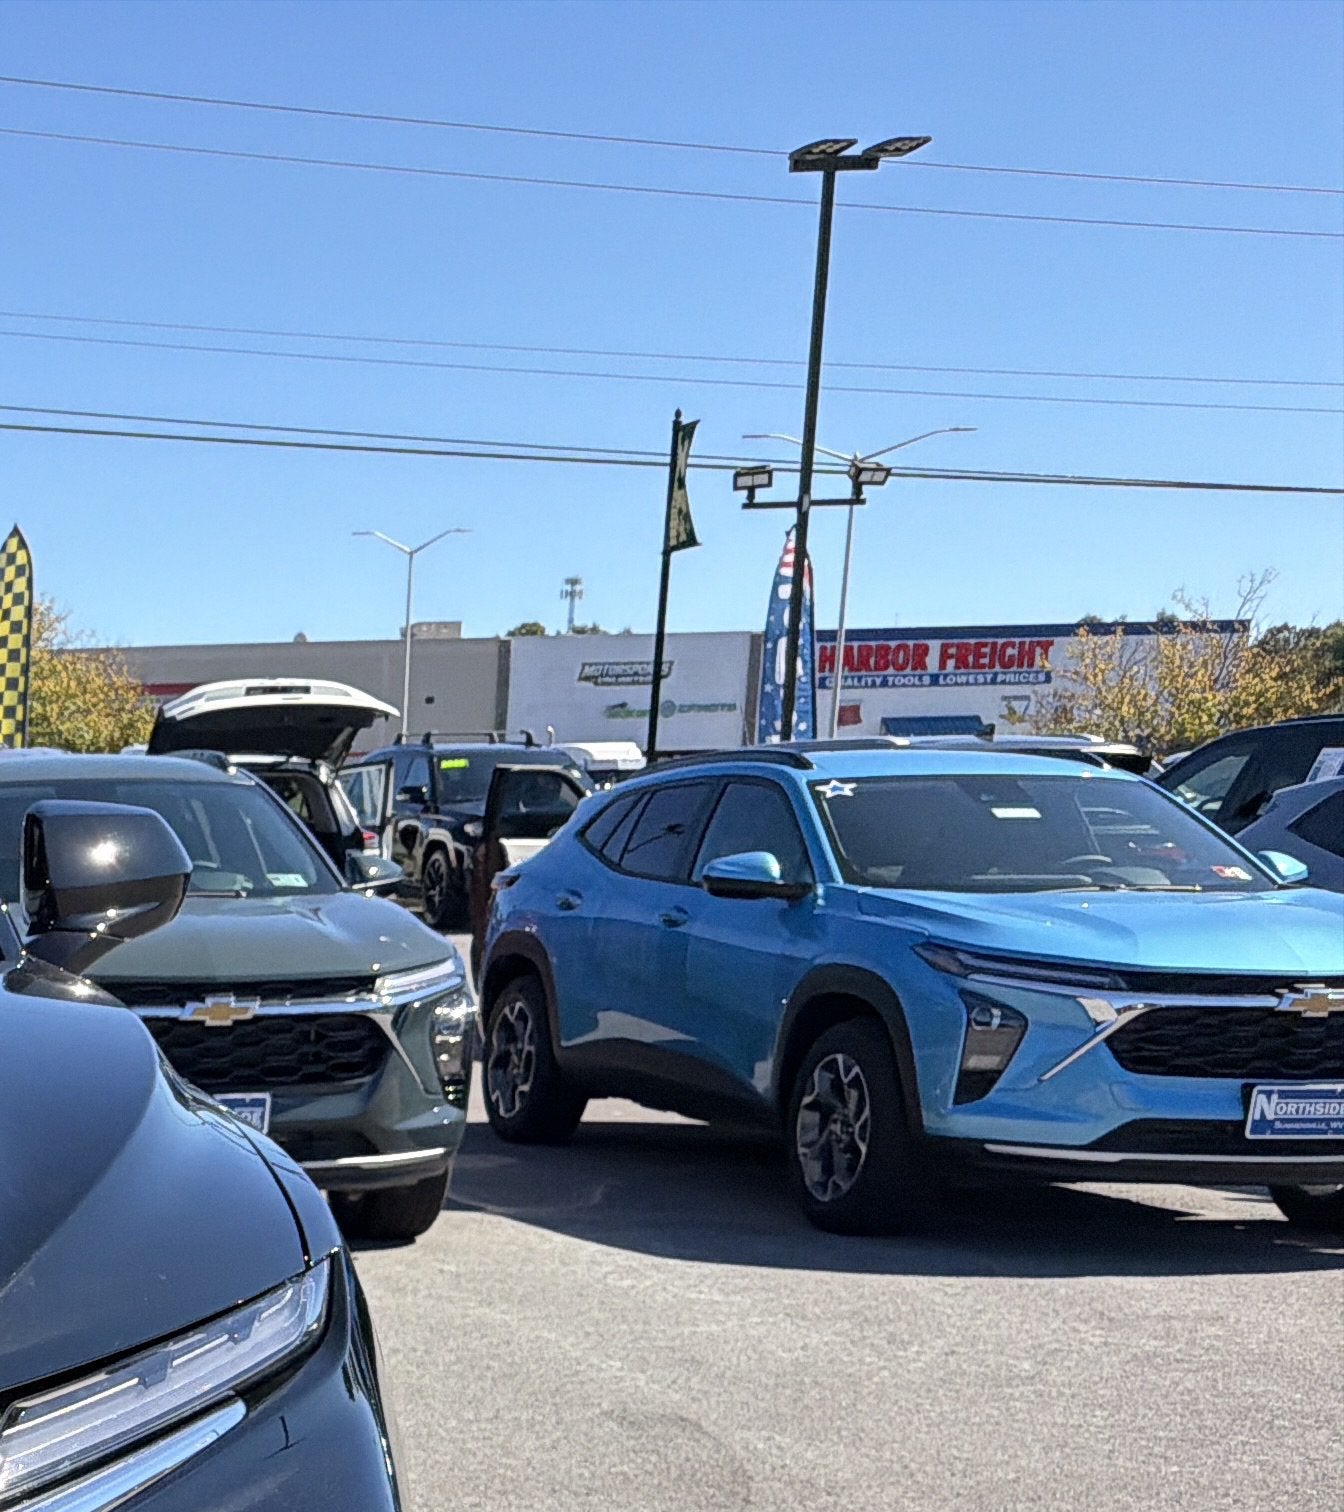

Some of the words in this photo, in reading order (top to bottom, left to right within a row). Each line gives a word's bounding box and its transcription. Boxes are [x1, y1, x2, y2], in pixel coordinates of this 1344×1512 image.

[818, 642, 930, 673] HARBOR
[938, 639, 1054, 671] FREIGHT
[581, 663, 671, 677] MOTORSPORS
[825, 675, 882, 687] QALITY
[887, 674, 931, 686] TOOLS
[939, 673, 994, 685] LOWEST
[996, 672, 1046, 683] PRICES
